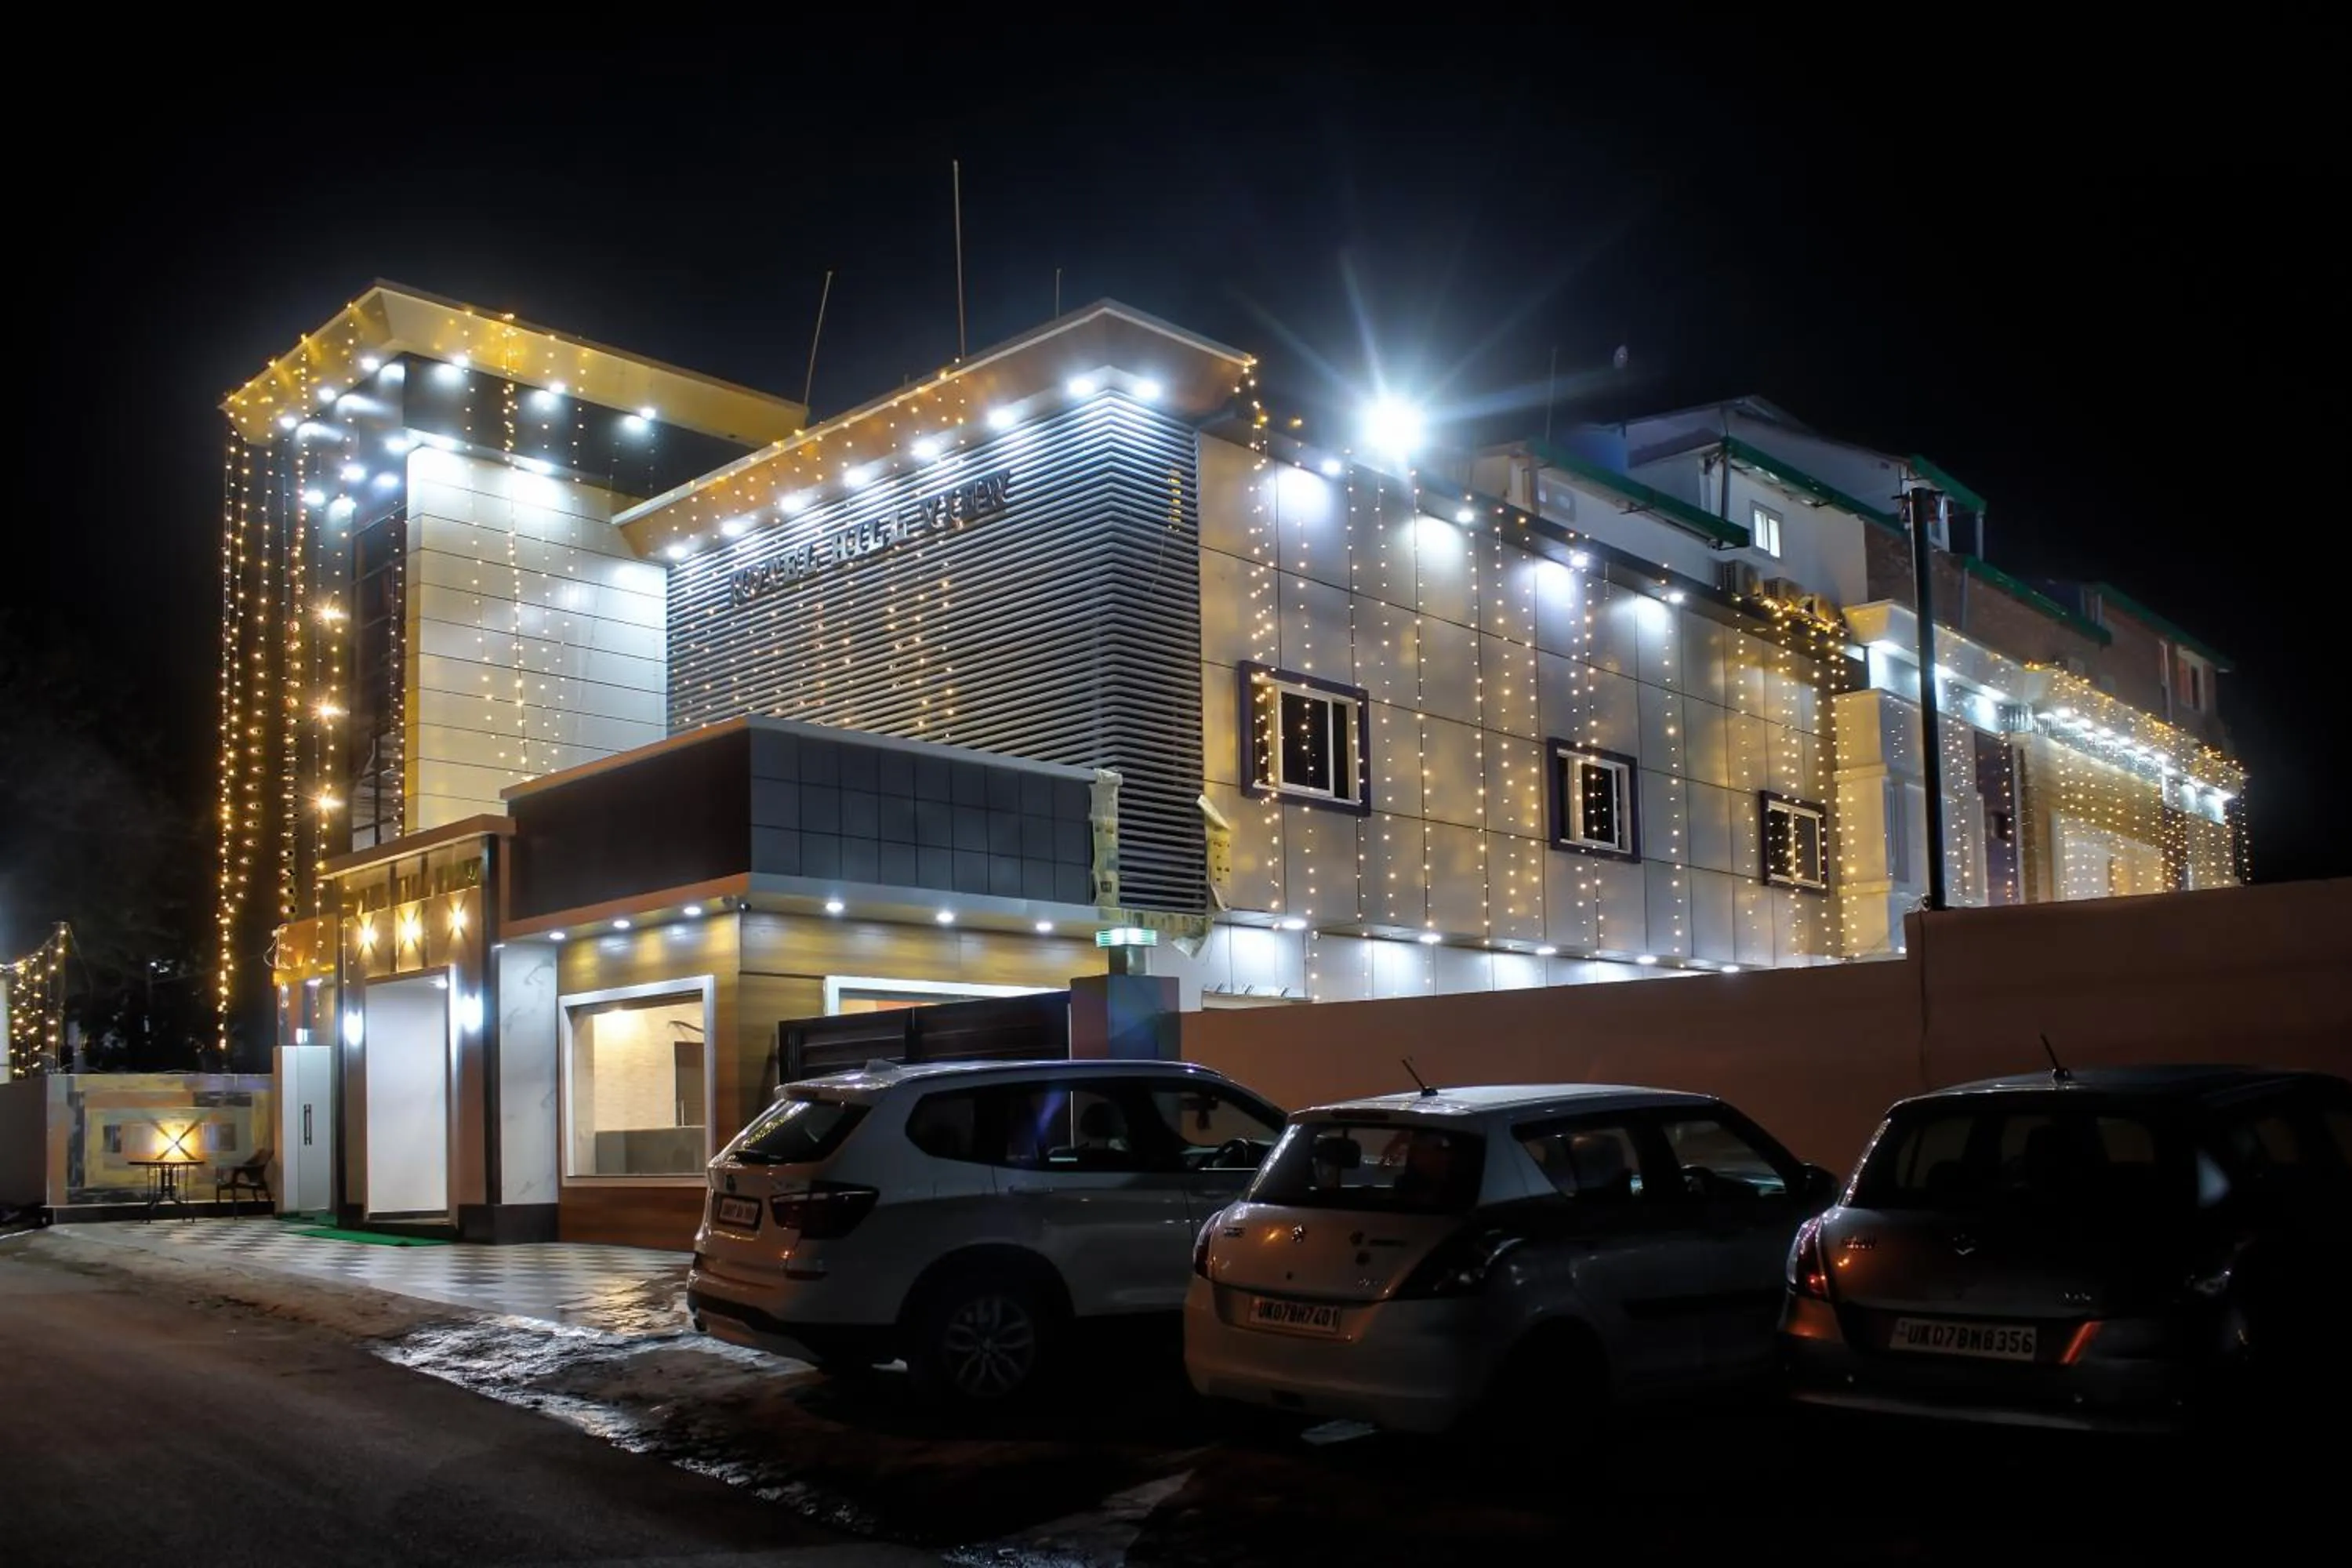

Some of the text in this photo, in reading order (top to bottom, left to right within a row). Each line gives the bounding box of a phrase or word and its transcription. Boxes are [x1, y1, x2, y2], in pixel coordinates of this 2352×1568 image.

[729, 470, 1011, 607] HOTEL HILL VIEW
